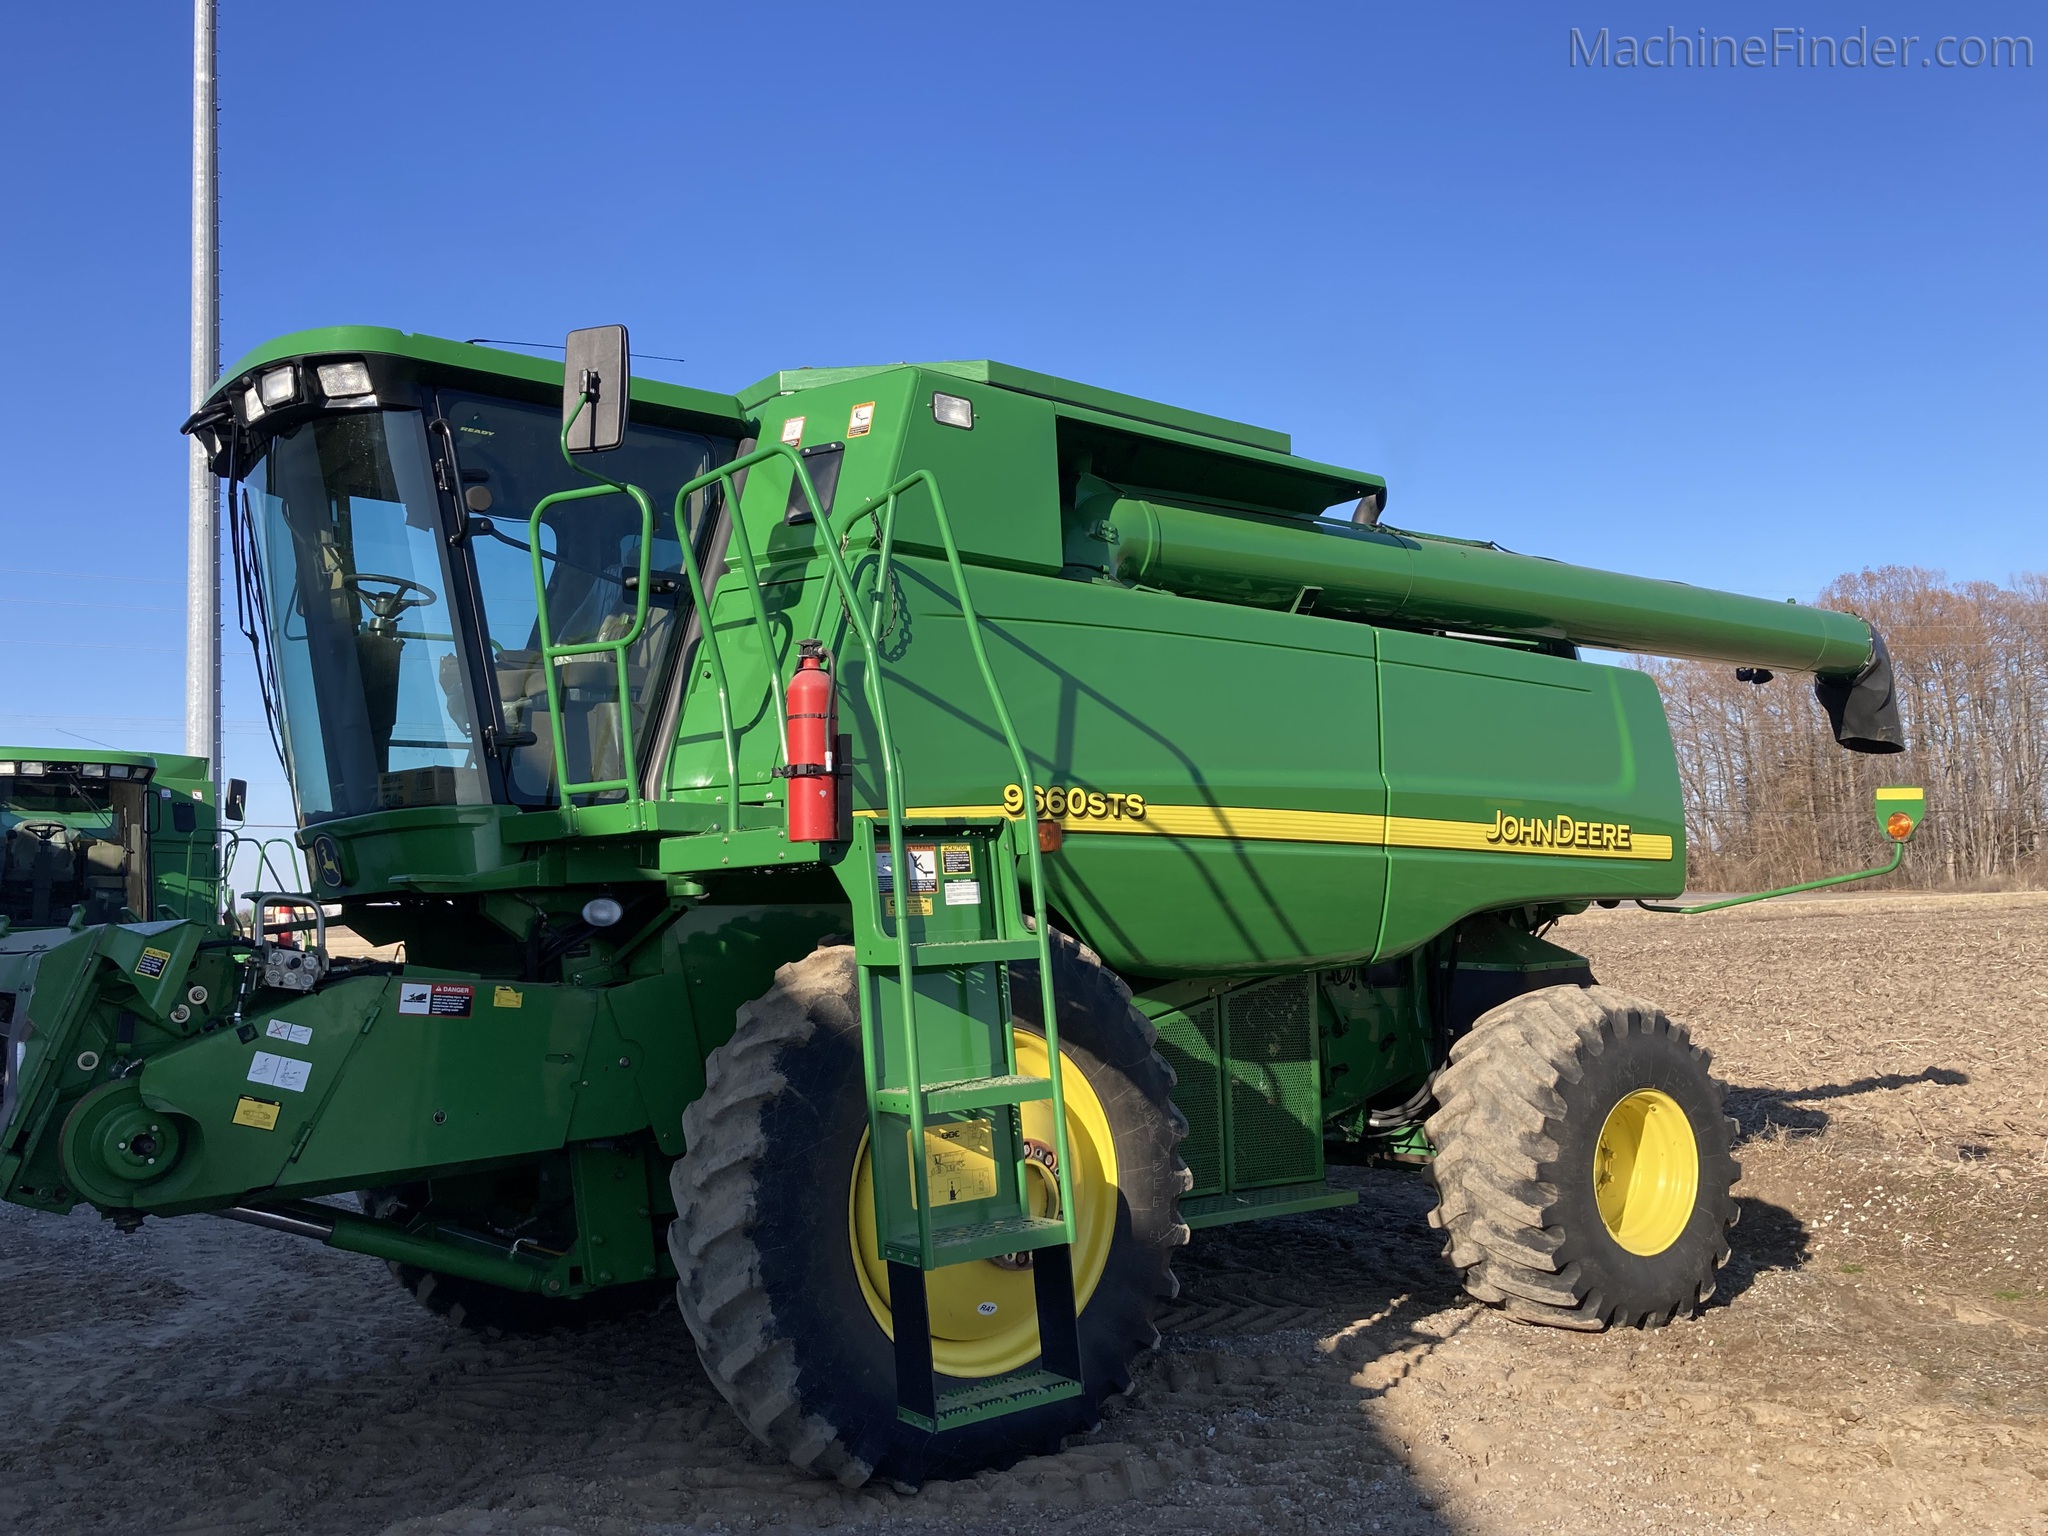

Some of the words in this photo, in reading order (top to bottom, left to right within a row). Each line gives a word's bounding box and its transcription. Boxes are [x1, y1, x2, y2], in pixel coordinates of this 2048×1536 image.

[460, 426, 495, 436] READY
[1486, 809, 1554, 847] JOHN
[1556, 814, 1632, 851] DEERE
[443, 986, 469, 994] DANGER
